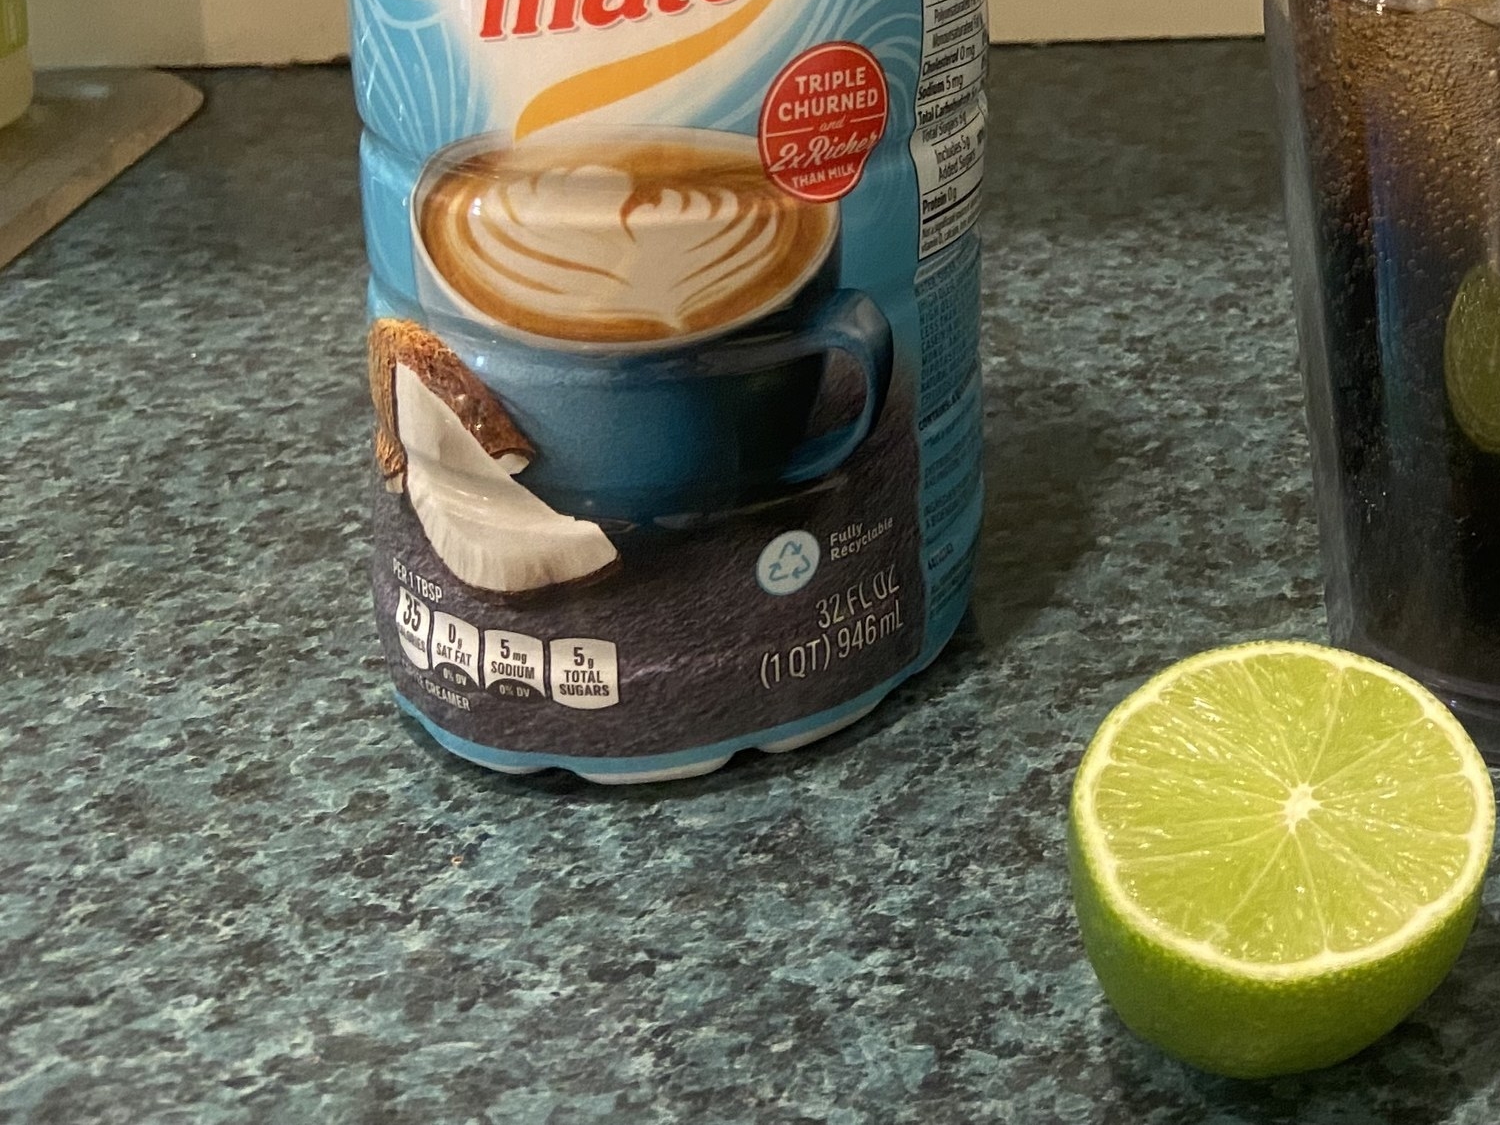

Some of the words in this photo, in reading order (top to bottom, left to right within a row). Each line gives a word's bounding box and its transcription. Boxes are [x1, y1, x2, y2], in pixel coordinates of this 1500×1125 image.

[922, 48, 959, 76] Cholesterol
[795, 66, 866, 94] TRIPLE
[918, 80, 945, 101] Sodium
[778, 88, 878, 122] CHURNED
[918, 106, 934, 125] Total
[819, 114, 847, 132] and
[803, 130, 879, 168] Richer
[934, 141, 961, 165] Includes
[792, 170, 826, 189] THAN
[828, 162, 856, 180] MILK
[939, 159, 958, 182] Added
[922, 192, 947, 214] Protein
[830, 523, 863, 546] Fully
[831, 517, 893, 561] Recyclable
[393, 557, 407, 584] PER
[409, 572, 413, 588] 1
[416, 575, 442, 603] TBSP
[816, 594, 844, 629] 32
[847, 582, 872, 615] FL
[873, 564, 900, 600] OZ
[403, 593, 421, 632] 35
[436, 642, 453, 660] SAT
[455, 651, 472, 667] FAT
[500, 639, 510, 659] 5
[513, 652, 527, 665] mg
[761, 653, 780, 689] (1
[789, 634, 831, 678] QT)
[838, 614, 876, 658] 946
[880, 600, 903, 638] mL
[491, 661, 535, 680] SODIUM
[573, 647, 584, 666] 5
[588, 658, 594, 669] g
[564, 670, 604, 683] TOTAL
[425, 682, 470, 711] CREAMER
[499, 684, 513, 695] 0%
[517, 687, 530, 697] DV
[559, 684, 610, 696] SUGARS
